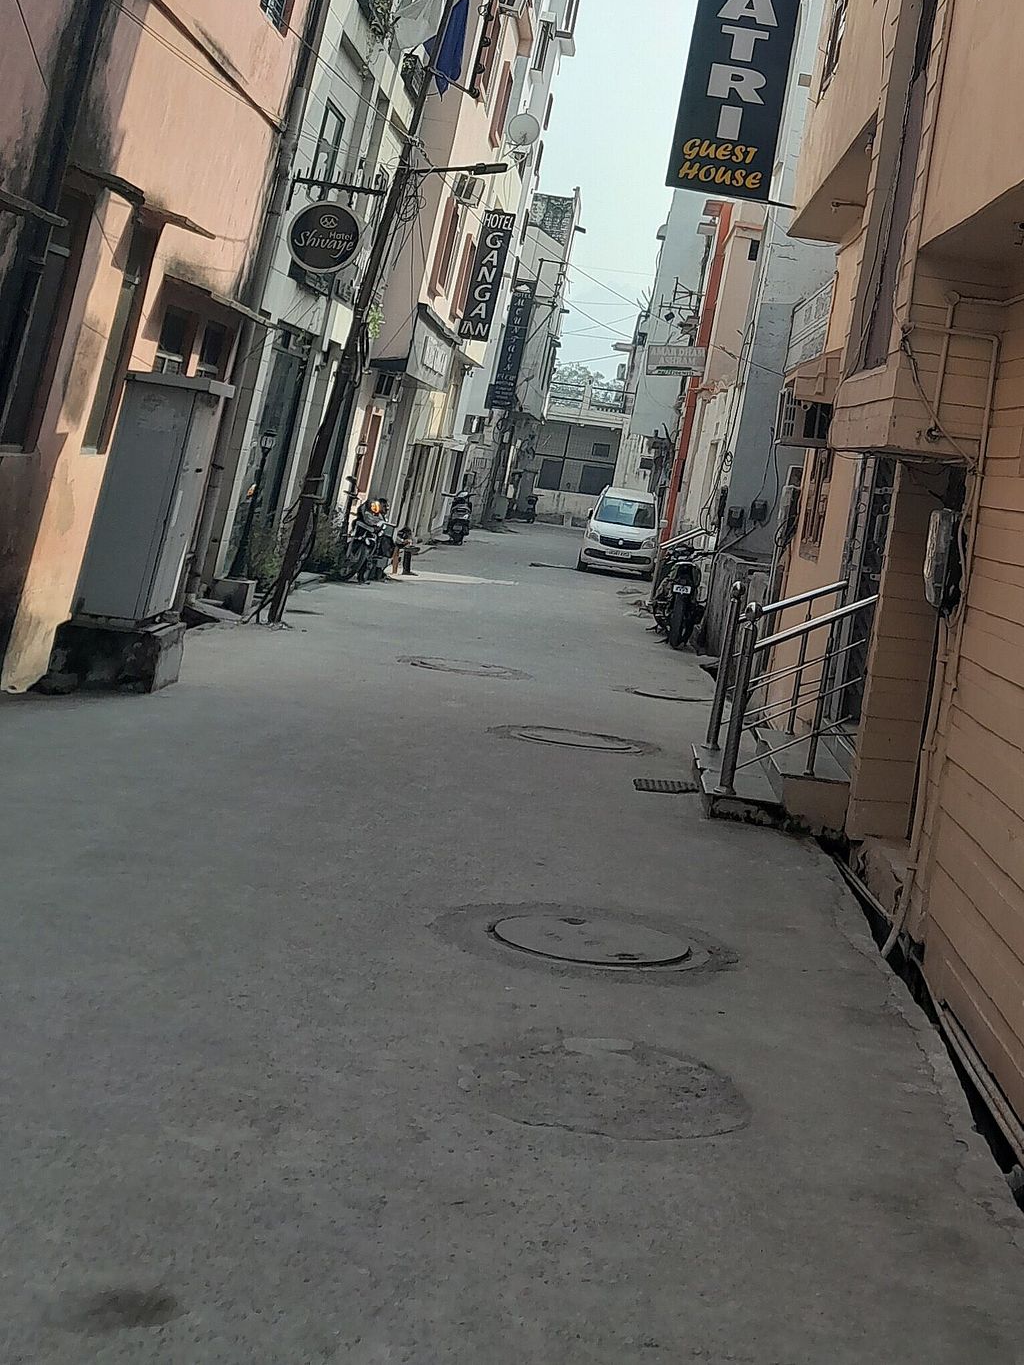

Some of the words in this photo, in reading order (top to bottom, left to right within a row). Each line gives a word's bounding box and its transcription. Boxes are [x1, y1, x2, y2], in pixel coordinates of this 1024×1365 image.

[682, 137, 758, 165] GUEST
[678, 160, 763, 189] HOUSE
[484, 213, 514, 232] HOTEL
[293, 229, 354, 259] Shivaye
[470, 232, 504, 320] GANGA
[460, 320, 489, 338] INN
